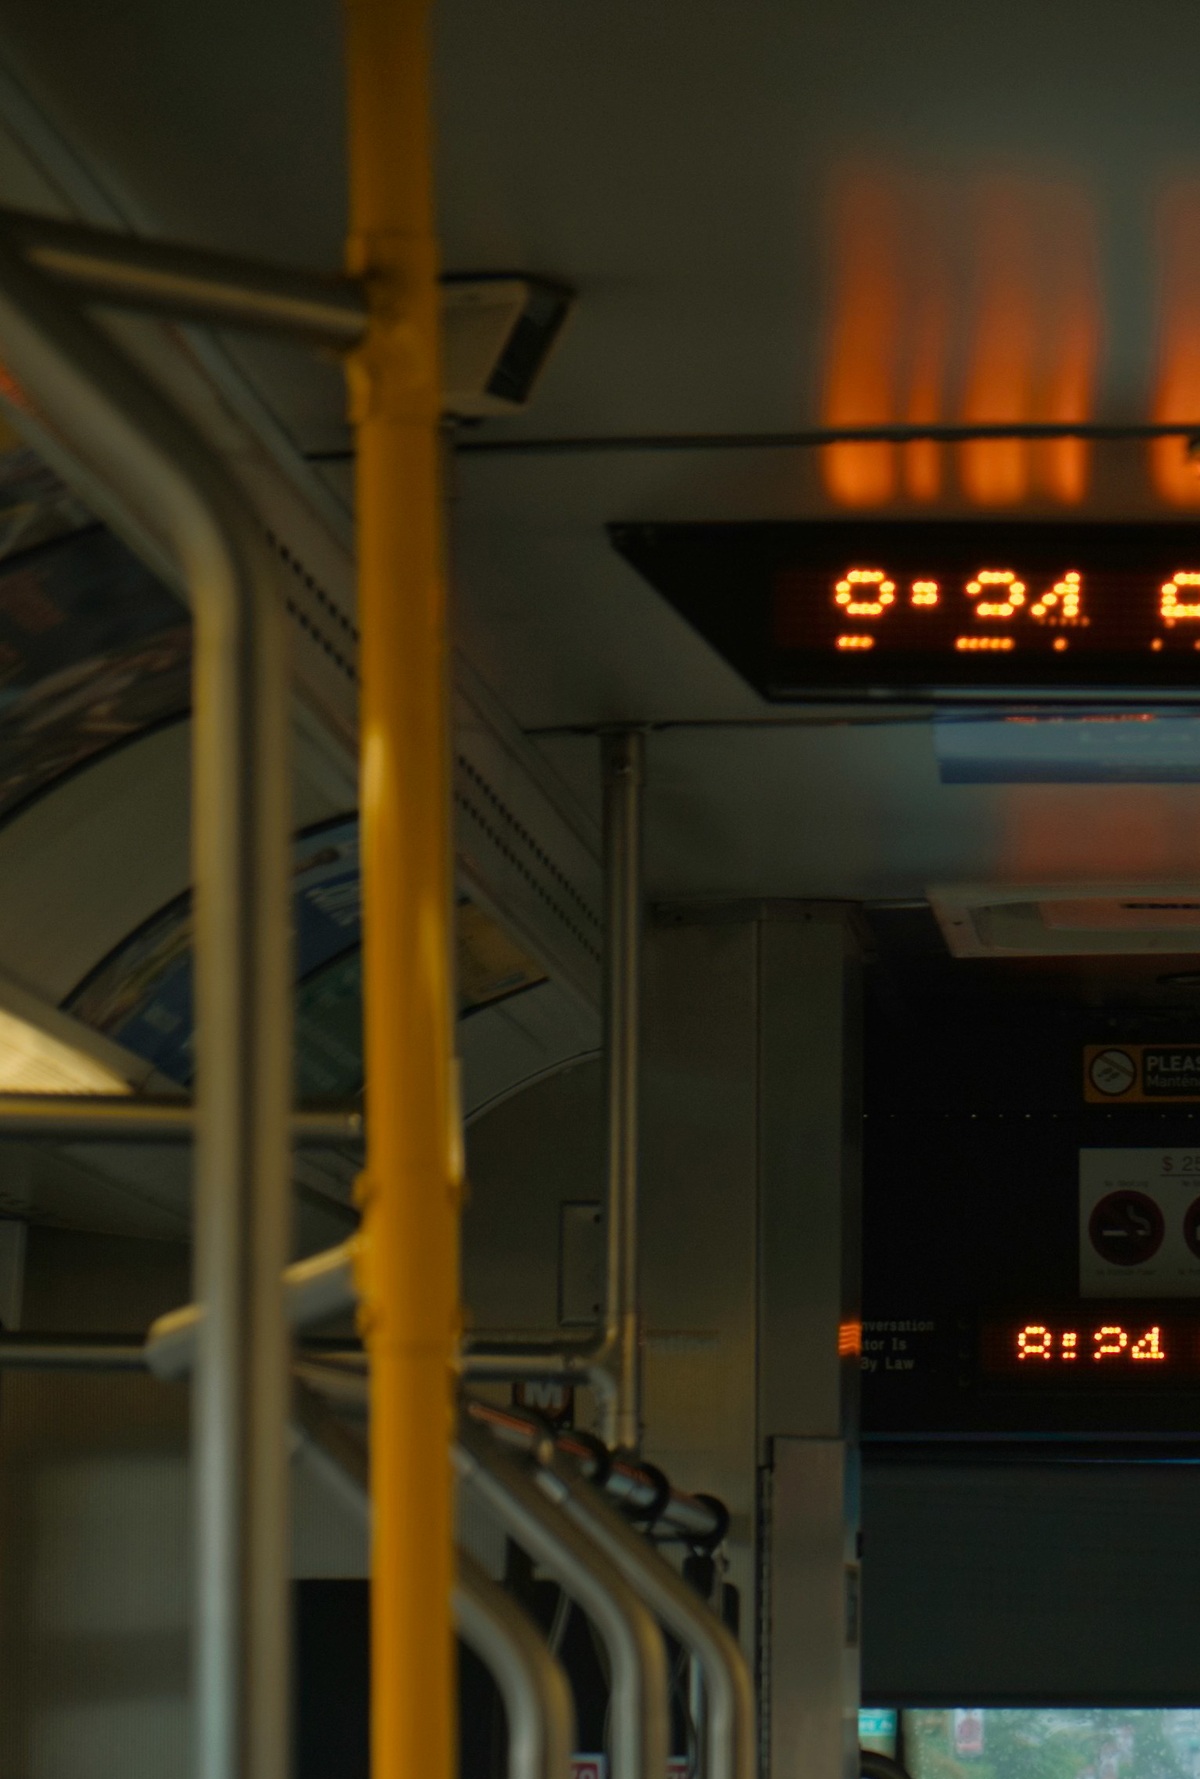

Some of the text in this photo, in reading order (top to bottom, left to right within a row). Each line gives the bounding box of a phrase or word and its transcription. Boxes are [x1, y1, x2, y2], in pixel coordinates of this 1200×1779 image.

[1162, 1155, 1174, 1173] $
[862, 1318, 935, 1333] nversation
[863, 1337, 885, 1351] tor
[885, 1355, 916, 1371] Law
